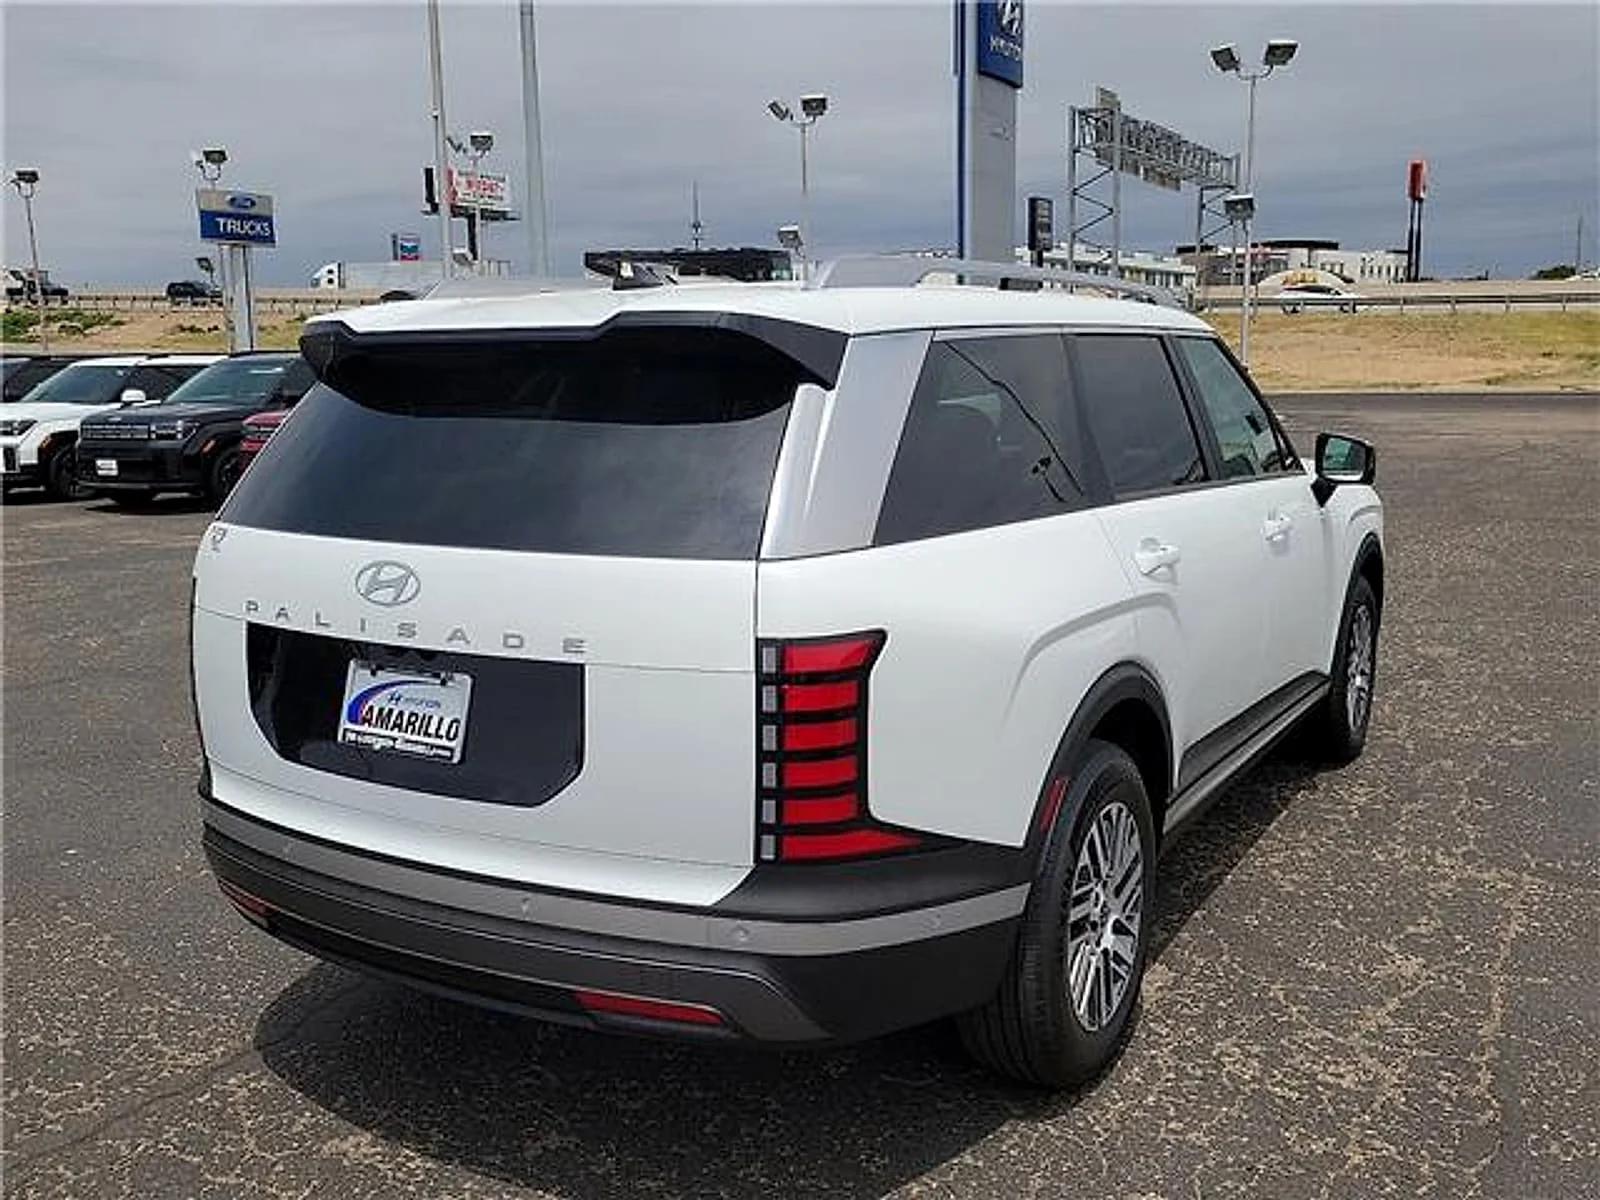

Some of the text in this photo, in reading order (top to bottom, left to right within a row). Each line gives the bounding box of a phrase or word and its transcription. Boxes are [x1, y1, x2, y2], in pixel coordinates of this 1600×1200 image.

[215, 217, 271, 236] TRUCKS
[245, 599, 588, 654] PALISADE
[362, 704, 461, 741] AMARILLO
